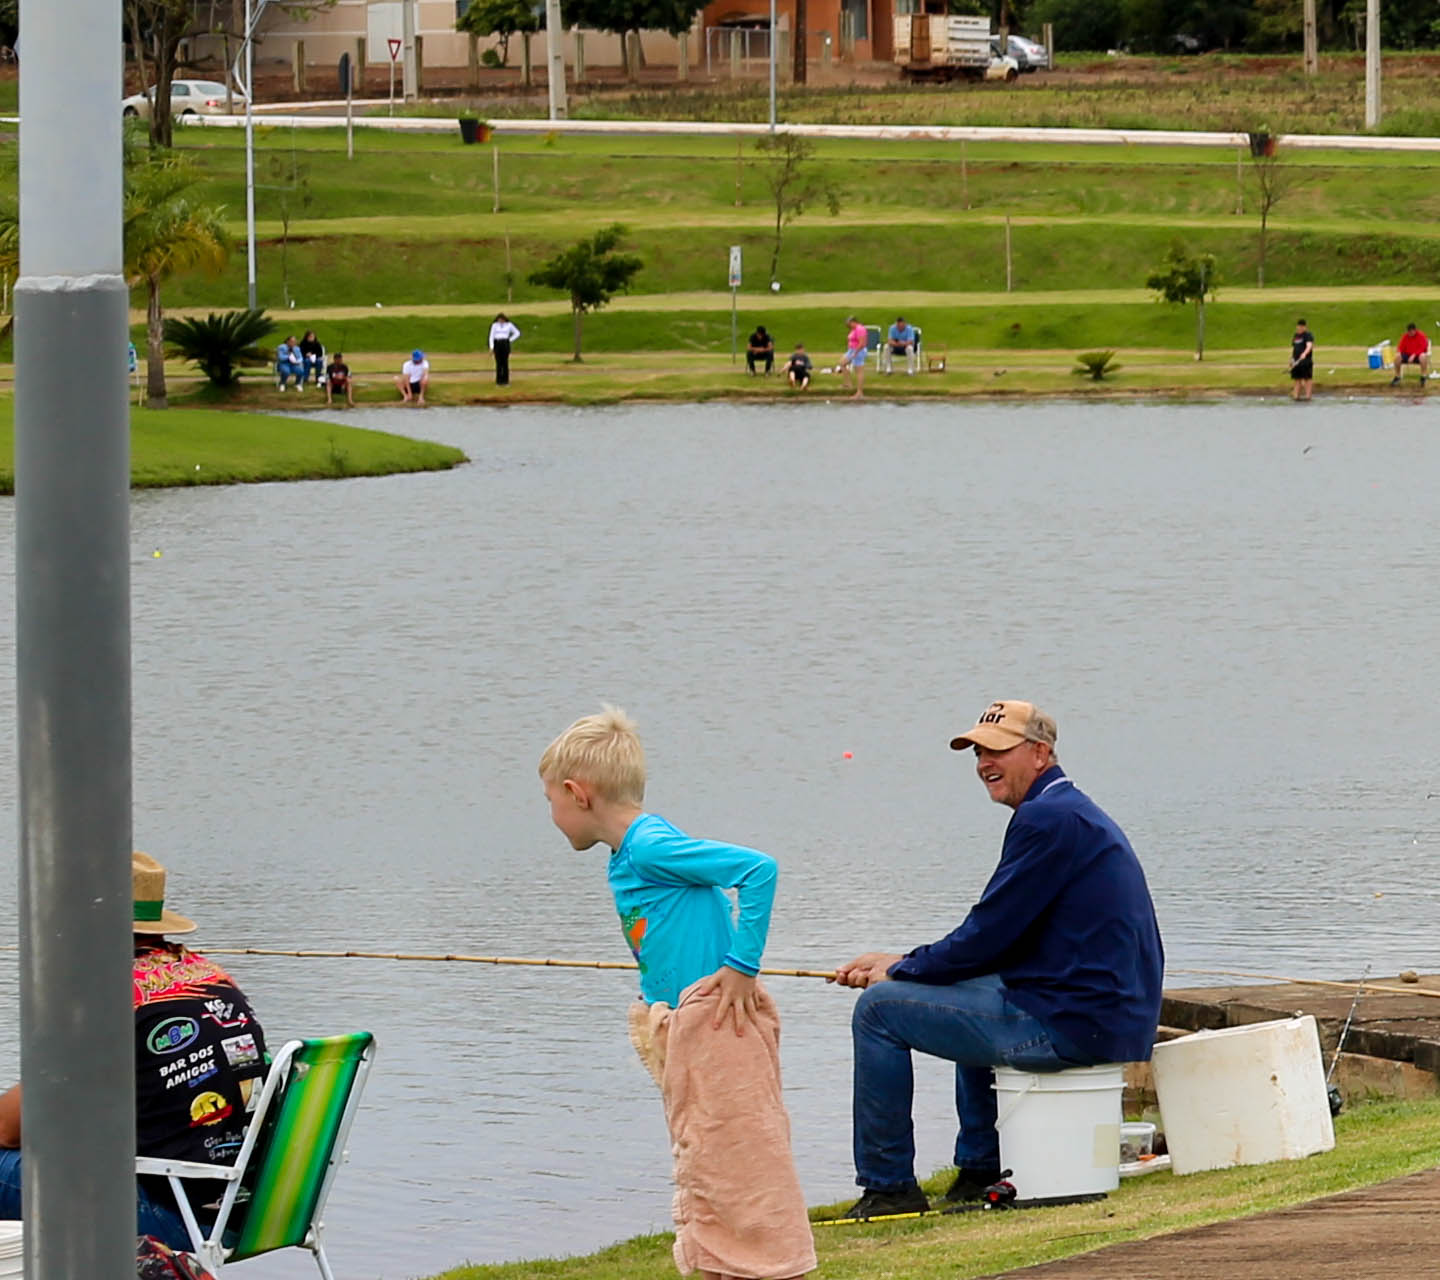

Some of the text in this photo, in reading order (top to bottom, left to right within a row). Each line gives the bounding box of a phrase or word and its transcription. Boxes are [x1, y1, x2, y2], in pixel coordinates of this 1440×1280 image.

[155, 1022, 193, 1051] MBM
[159, 1058, 187, 1077] BAR
[189, 1045, 214, 1063] DOS
[166, 1059, 215, 1089] AMIGOS
